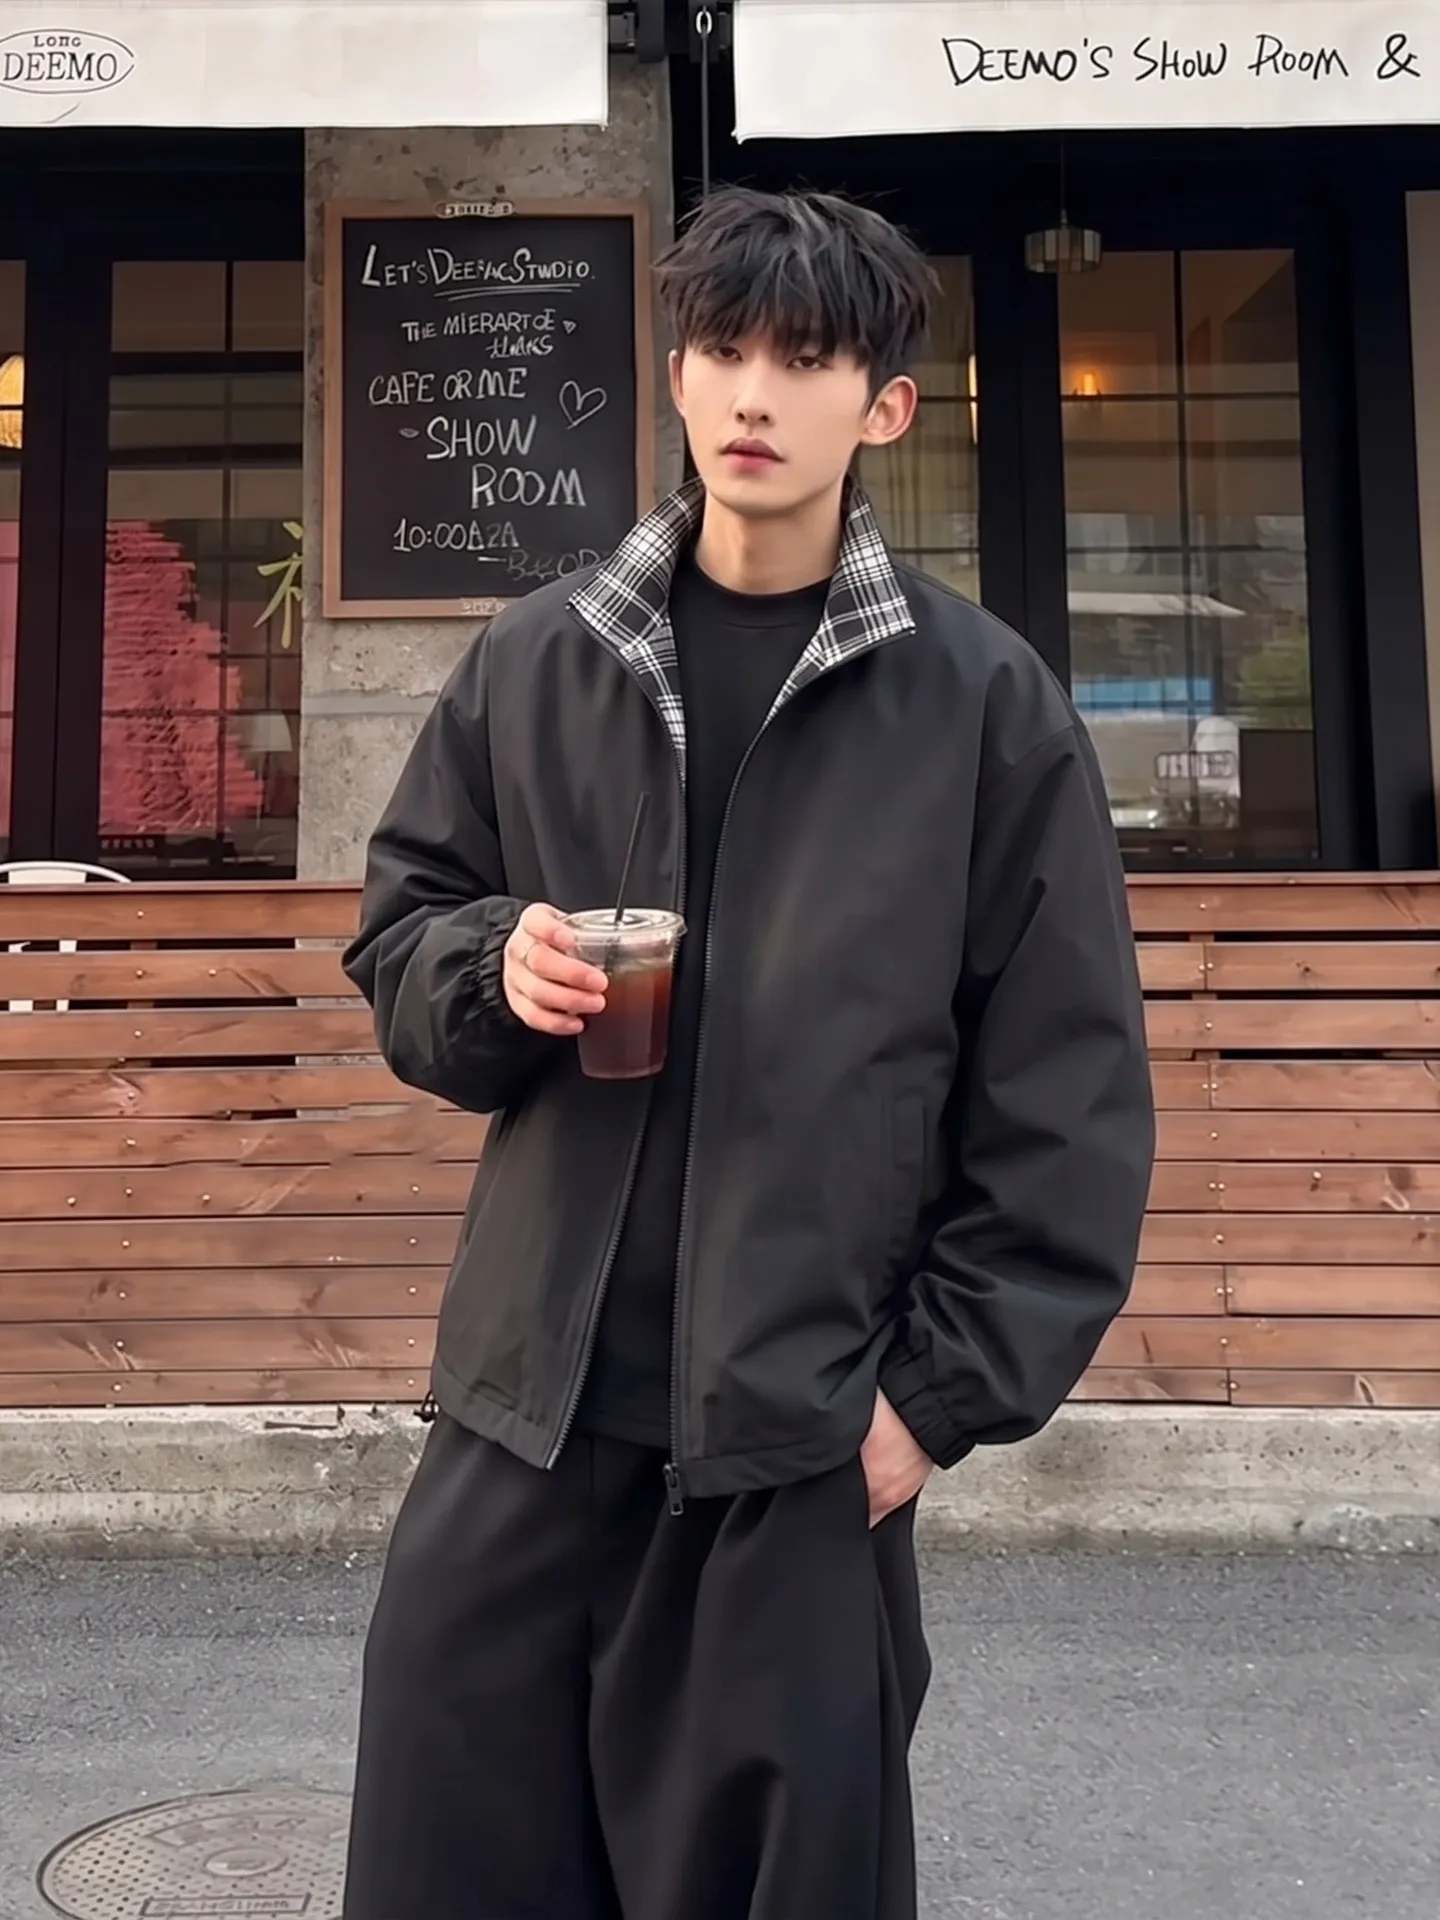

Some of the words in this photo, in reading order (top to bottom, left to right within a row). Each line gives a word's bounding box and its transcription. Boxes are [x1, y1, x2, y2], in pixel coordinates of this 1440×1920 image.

[3, 51, 118, 82] DEEMO
[941, 37, 1113, 86] DEEMO'S
[1377, 33, 1421, 80] &
[368, 370, 435, 405] CAFE
[426, 415, 537, 459] SHOW
[470, 462, 587, 510] ROOM
